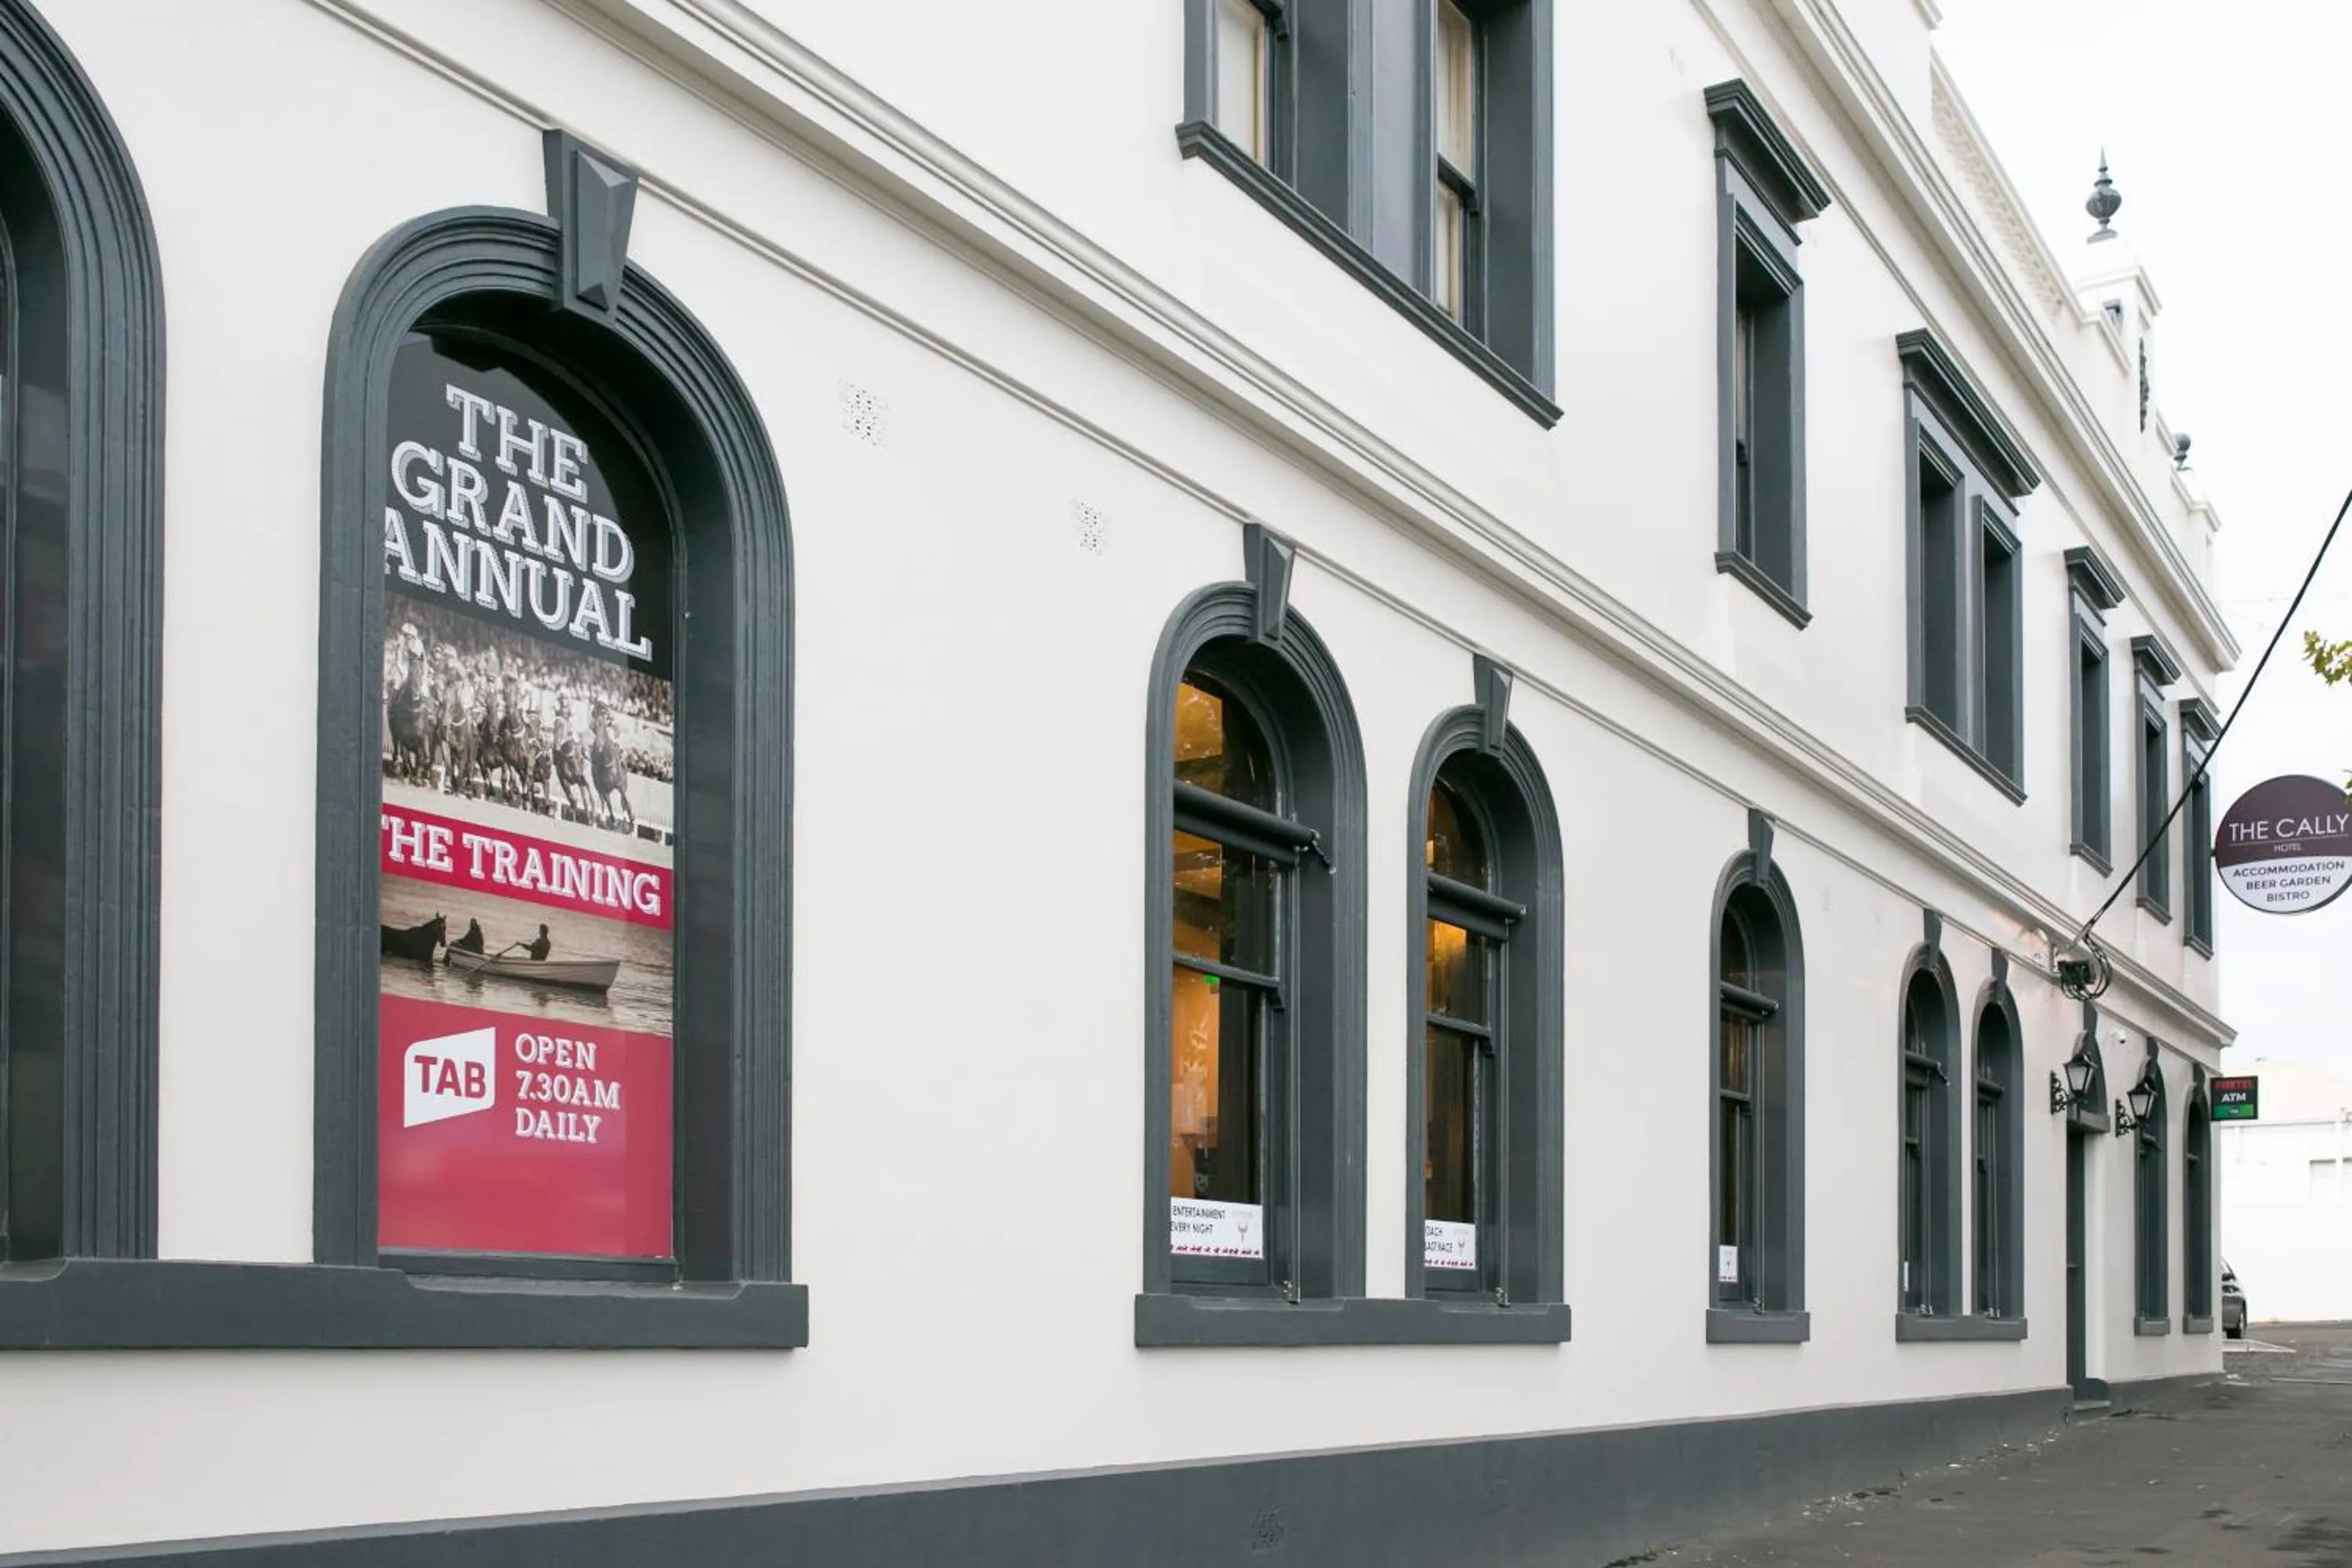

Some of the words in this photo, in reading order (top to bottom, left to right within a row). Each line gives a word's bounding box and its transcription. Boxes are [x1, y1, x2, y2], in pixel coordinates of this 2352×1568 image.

[446, 383, 588, 503] THE
[391, 440, 634, 583] GRAND
[384, 506, 652, 662] ANNUAL
[2229, 820, 2270, 841] THE
[2276, 813, 2350, 838] CALLY
[462, 833, 661, 916] TRAINING
[2233, 860, 2345, 878] ACCOMMODATION
[2246, 879, 2277, 891] BEER
[2279, 876, 2331, 888] GARDEN
[2267, 890, 2310, 902] BISTRO
[515, 1033, 597, 1071] OPEN
[414, 1054, 486, 1099] TAB
[515, 1070, 621, 1110] 7.30AM
[2221, 1092, 2246, 1103] ATM
[515, 1108, 602, 1143] DAILY
[1170, 1221, 1191, 1232] EVERY
[1192, 1223, 1214, 1234] NIGHT
[1172, 1205, 1225, 1219] ENTERTAINMENT
